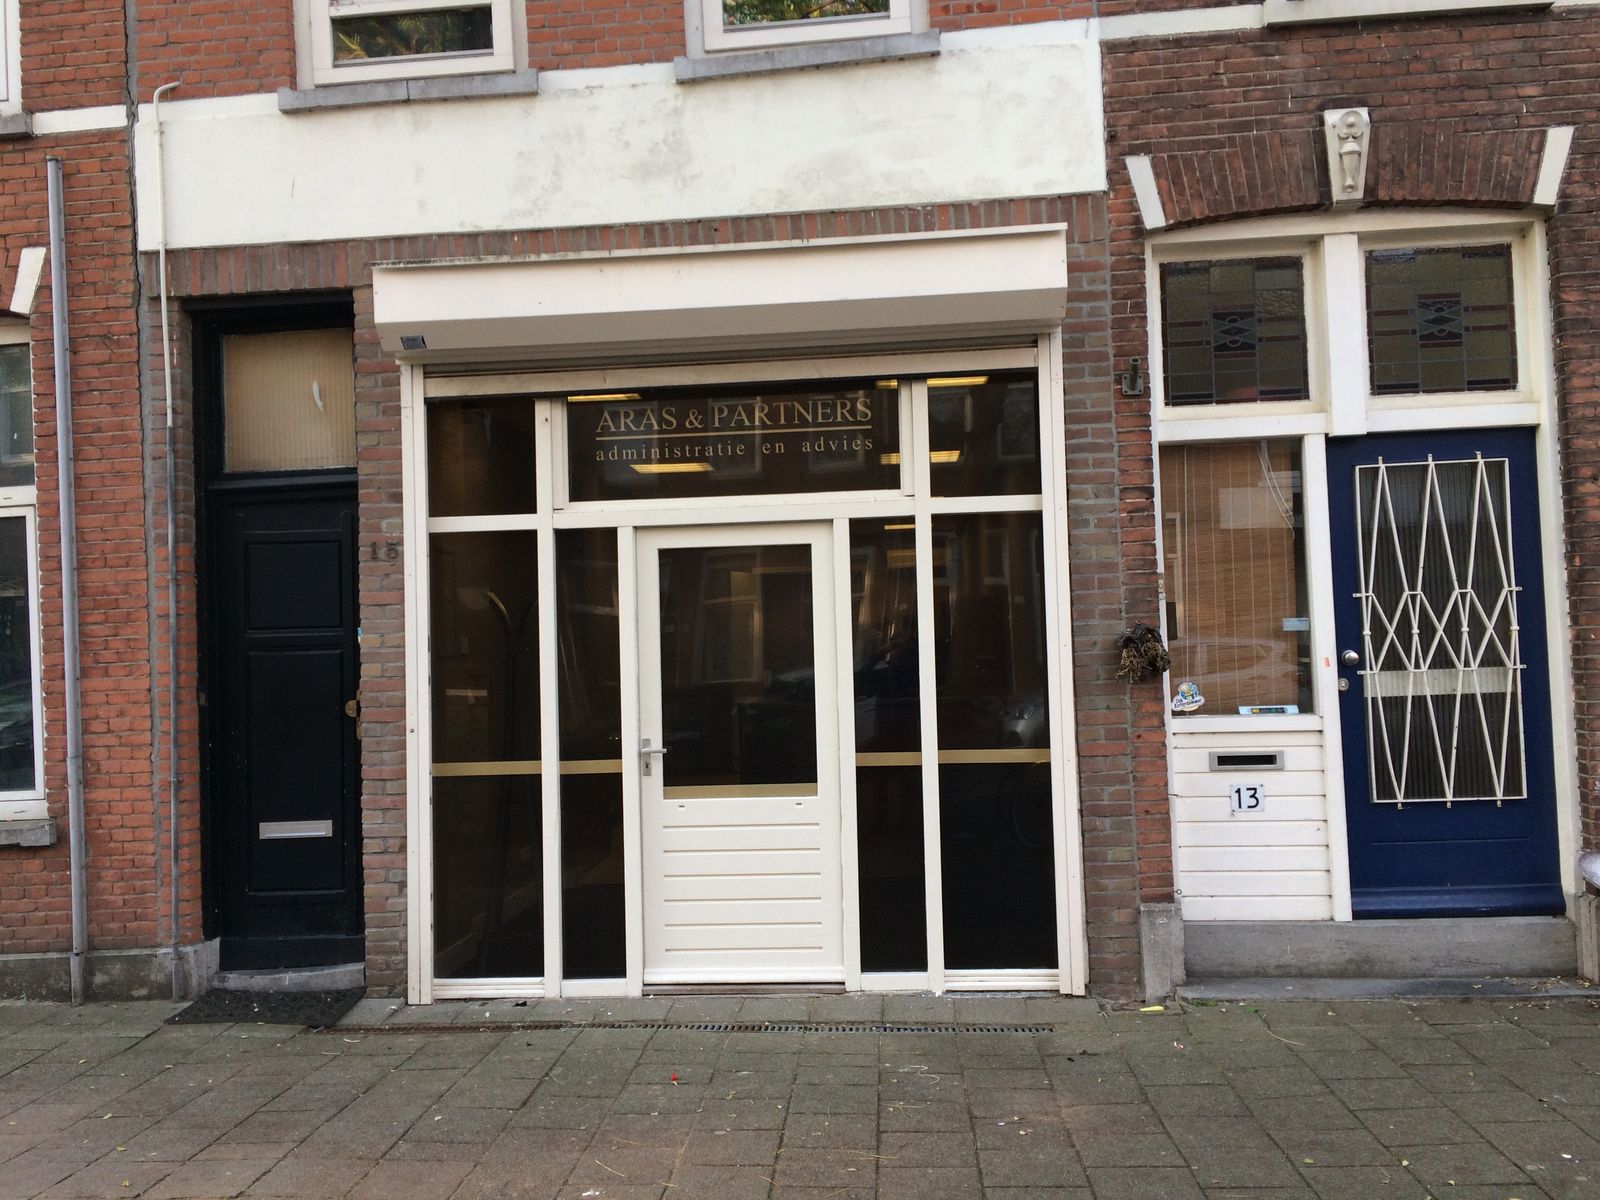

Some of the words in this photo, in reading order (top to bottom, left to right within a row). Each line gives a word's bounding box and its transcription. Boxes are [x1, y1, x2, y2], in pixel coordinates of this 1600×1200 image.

[596, 407, 678, 433] ARAS
[685, 409, 705, 429] &
[712, 398, 872, 428] PARTNERS
[596, 440, 745, 461] administratie
[762, 442, 785, 455] en
[802, 435, 873, 453] advies
[371, 541, 400, 560] 15
[1235, 787, 1260, 809] 13
